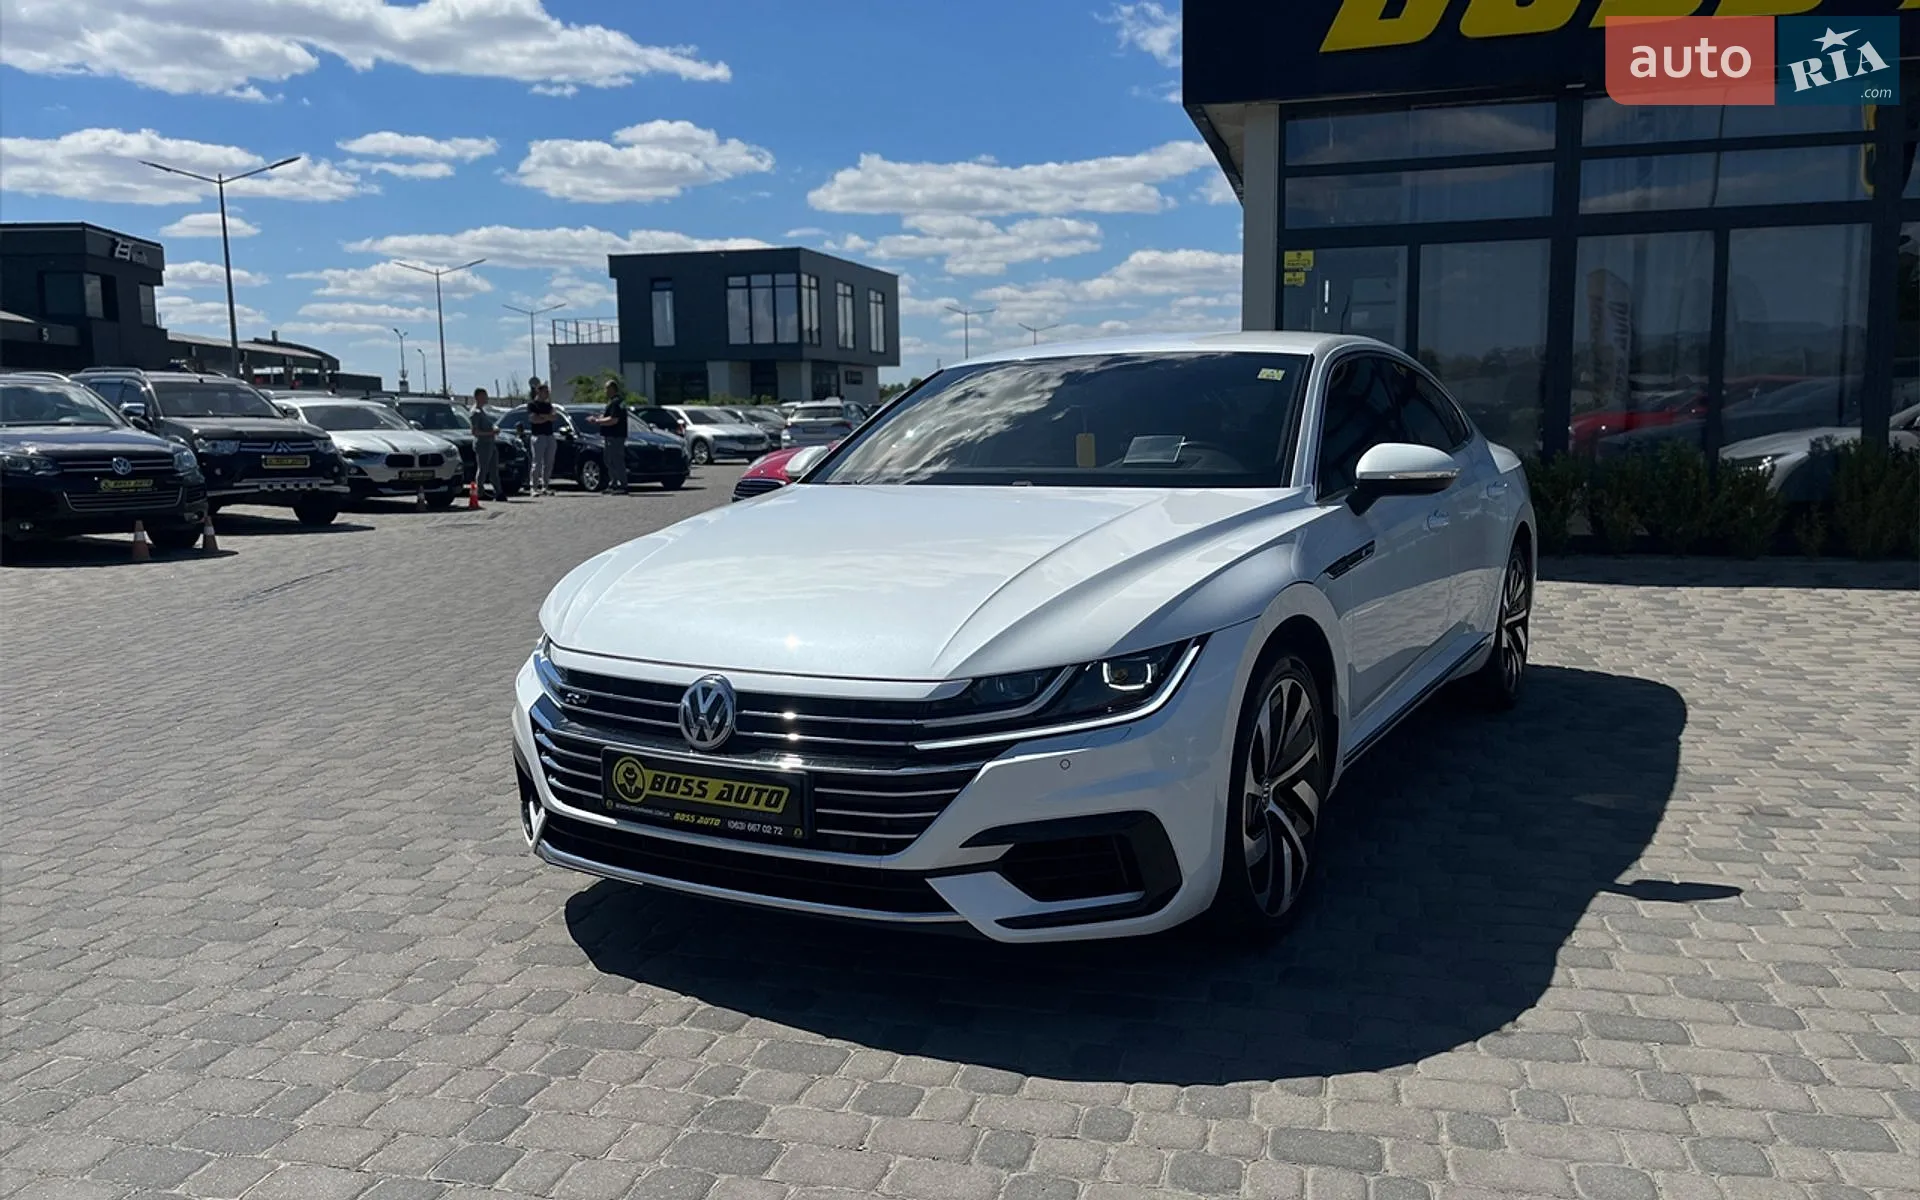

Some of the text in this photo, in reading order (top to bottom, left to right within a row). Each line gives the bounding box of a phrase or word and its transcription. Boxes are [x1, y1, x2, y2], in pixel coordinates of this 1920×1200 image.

[649, 773, 785, 808] BOSS AUTO
[673, 812, 696, 824] BOSS
